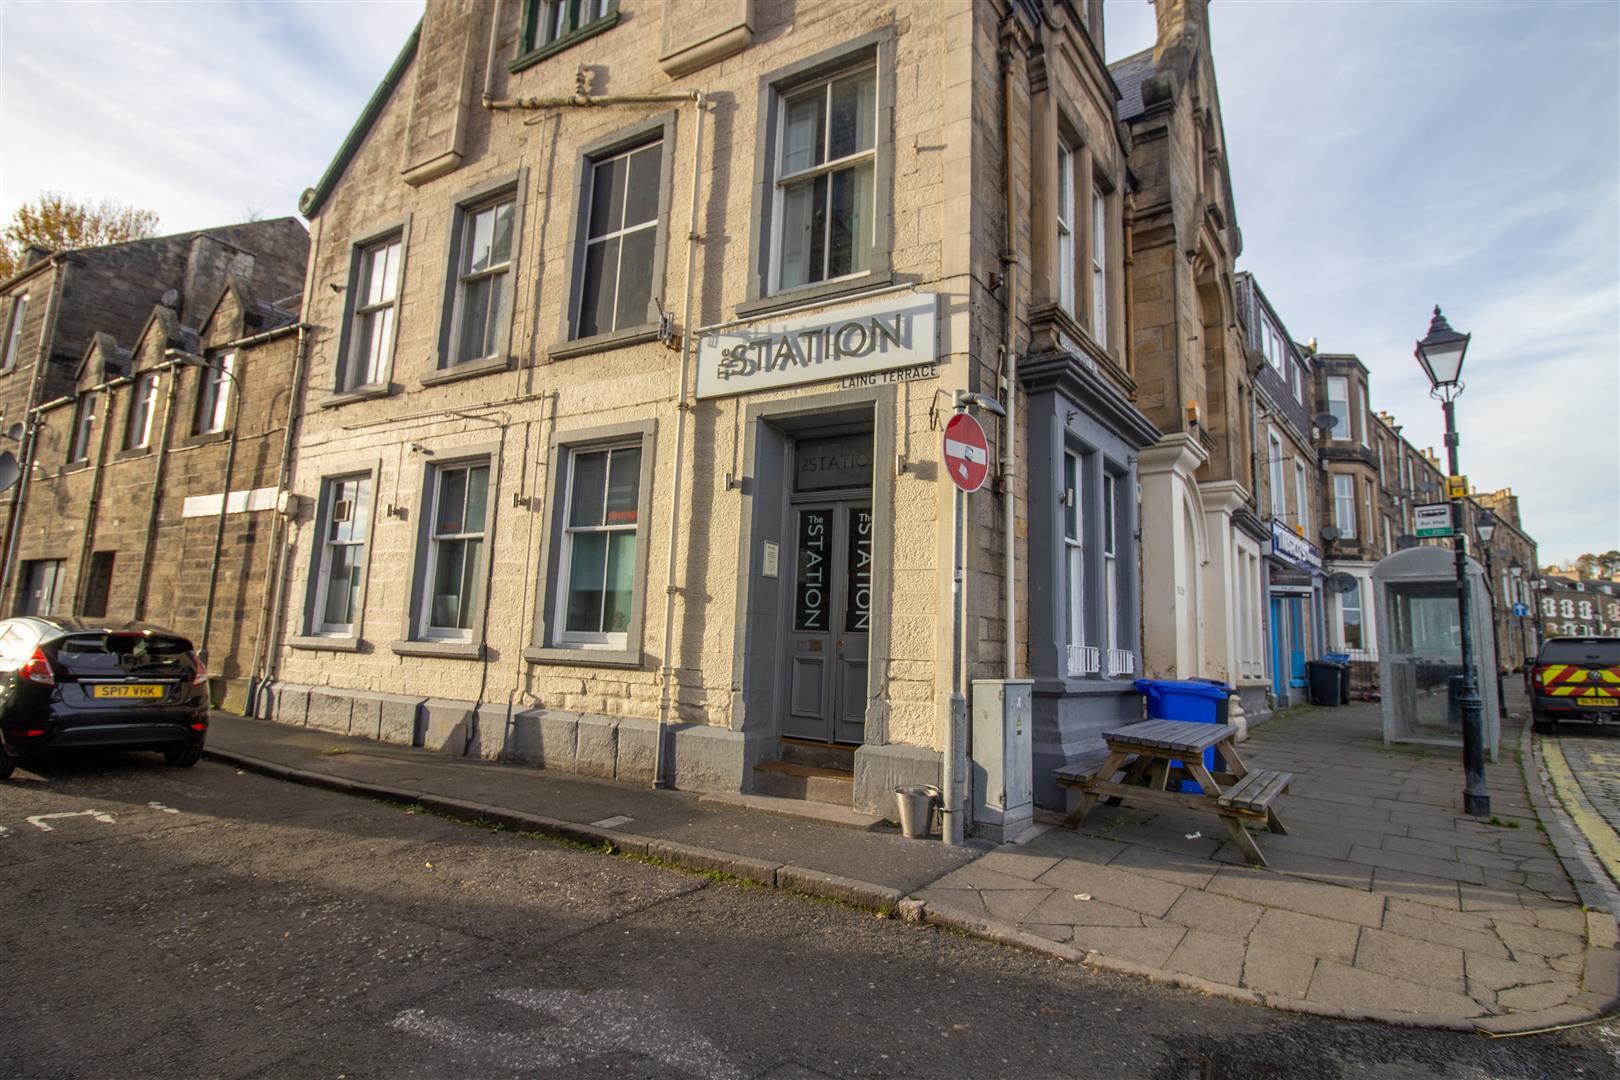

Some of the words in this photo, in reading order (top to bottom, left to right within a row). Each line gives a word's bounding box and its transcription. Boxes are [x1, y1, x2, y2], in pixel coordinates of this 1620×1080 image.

[731, 314, 901, 376] STATION
[842, 374, 876, 389] LAING
[881, 364, 937, 383] TERRACE
[809, 453, 868, 472] STATIO
[808, 515, 824, 524] The
[859, 513, 872, 522] Th
[804, 524, 824, 627] STATION
[102, 686, 129, 696] SP17
[133, 686, 154, 695] VHK
